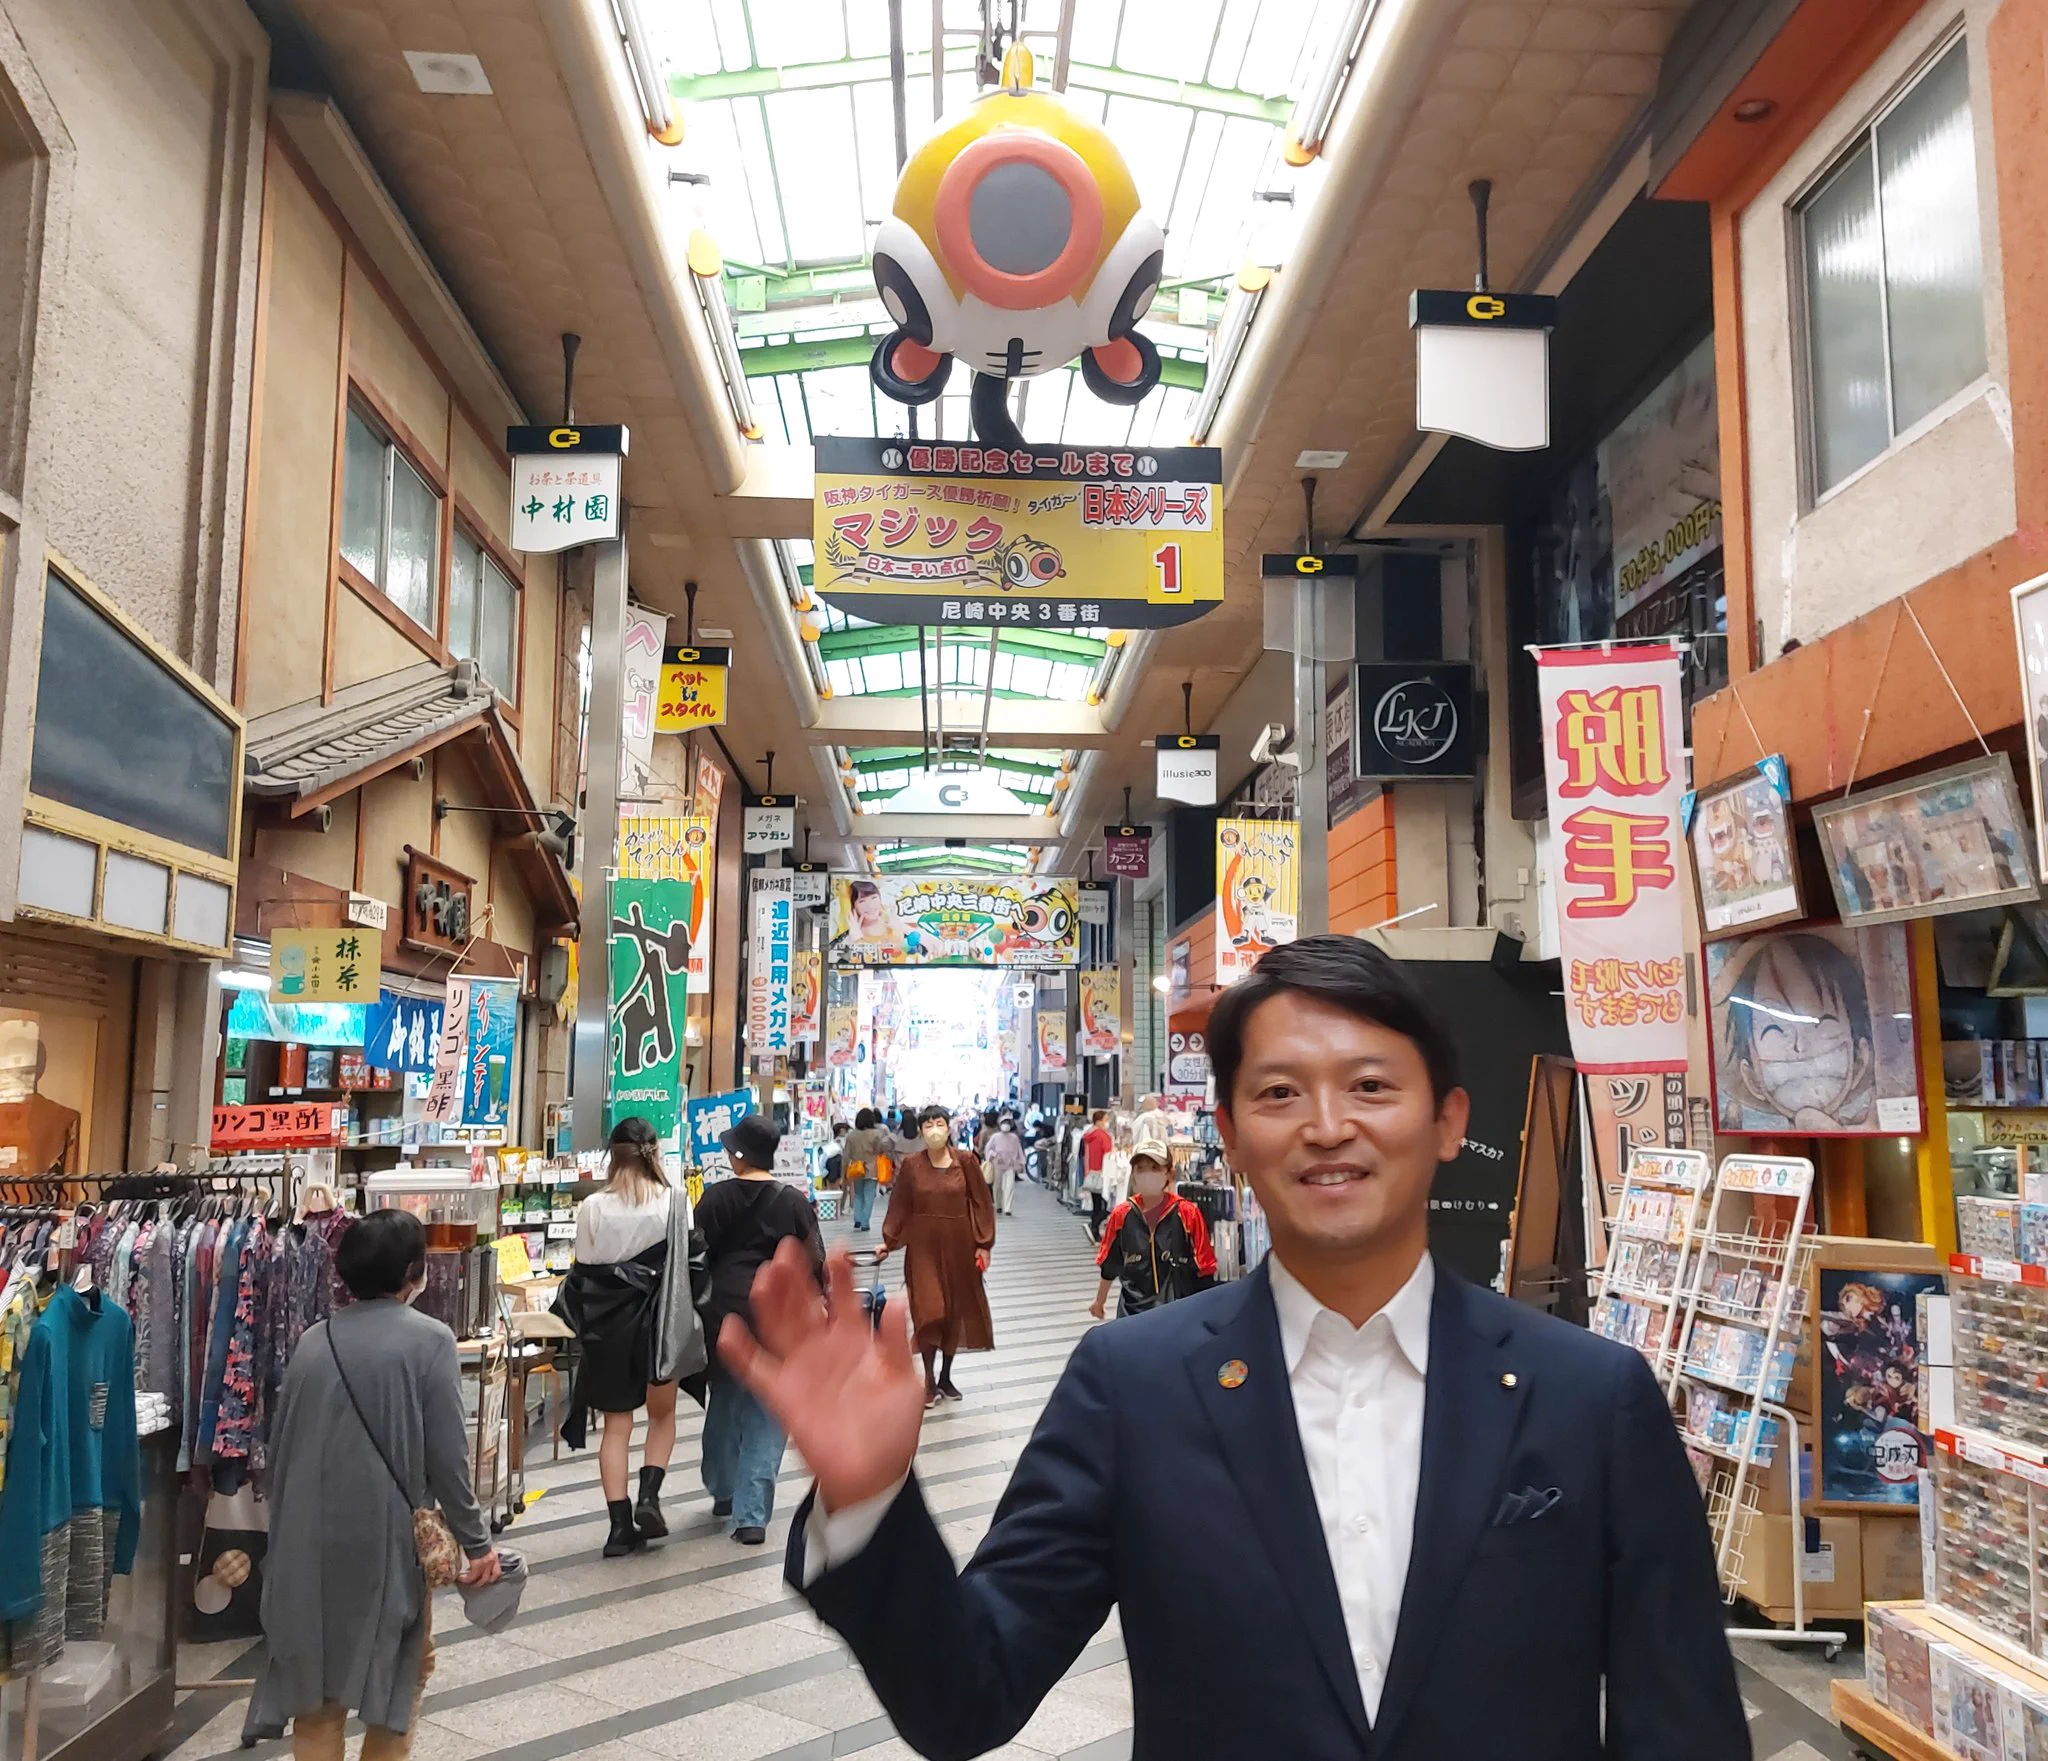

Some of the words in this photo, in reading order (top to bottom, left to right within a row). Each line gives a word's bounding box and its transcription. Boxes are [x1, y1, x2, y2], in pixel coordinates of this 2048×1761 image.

[907, 446, 1135, 477] 優勝記念セールまで
[521, 494, 609, 524] 中村園
[1082, 484, 1208, 526] 日本シリーズ
[832, 505, 1005, 554] マジック
[1155, 541, 1182, 593] 1
[941, 600, 1101, 624] 尼崎中央3番街
[671, 671, 708, 687] ペット
[661, 702, 717, 718] スタイル
[1381, 692, 1449, 740] LKJ
[747, 831, 790, 841] アマガン
[629, 840, 686, 864] てっぺん
[335, 936, 361, 992] 抹茶
[473, 988, 493, 1110] グリーンティー
[213, 1107, 325, 1133] リンゴ黒酢
